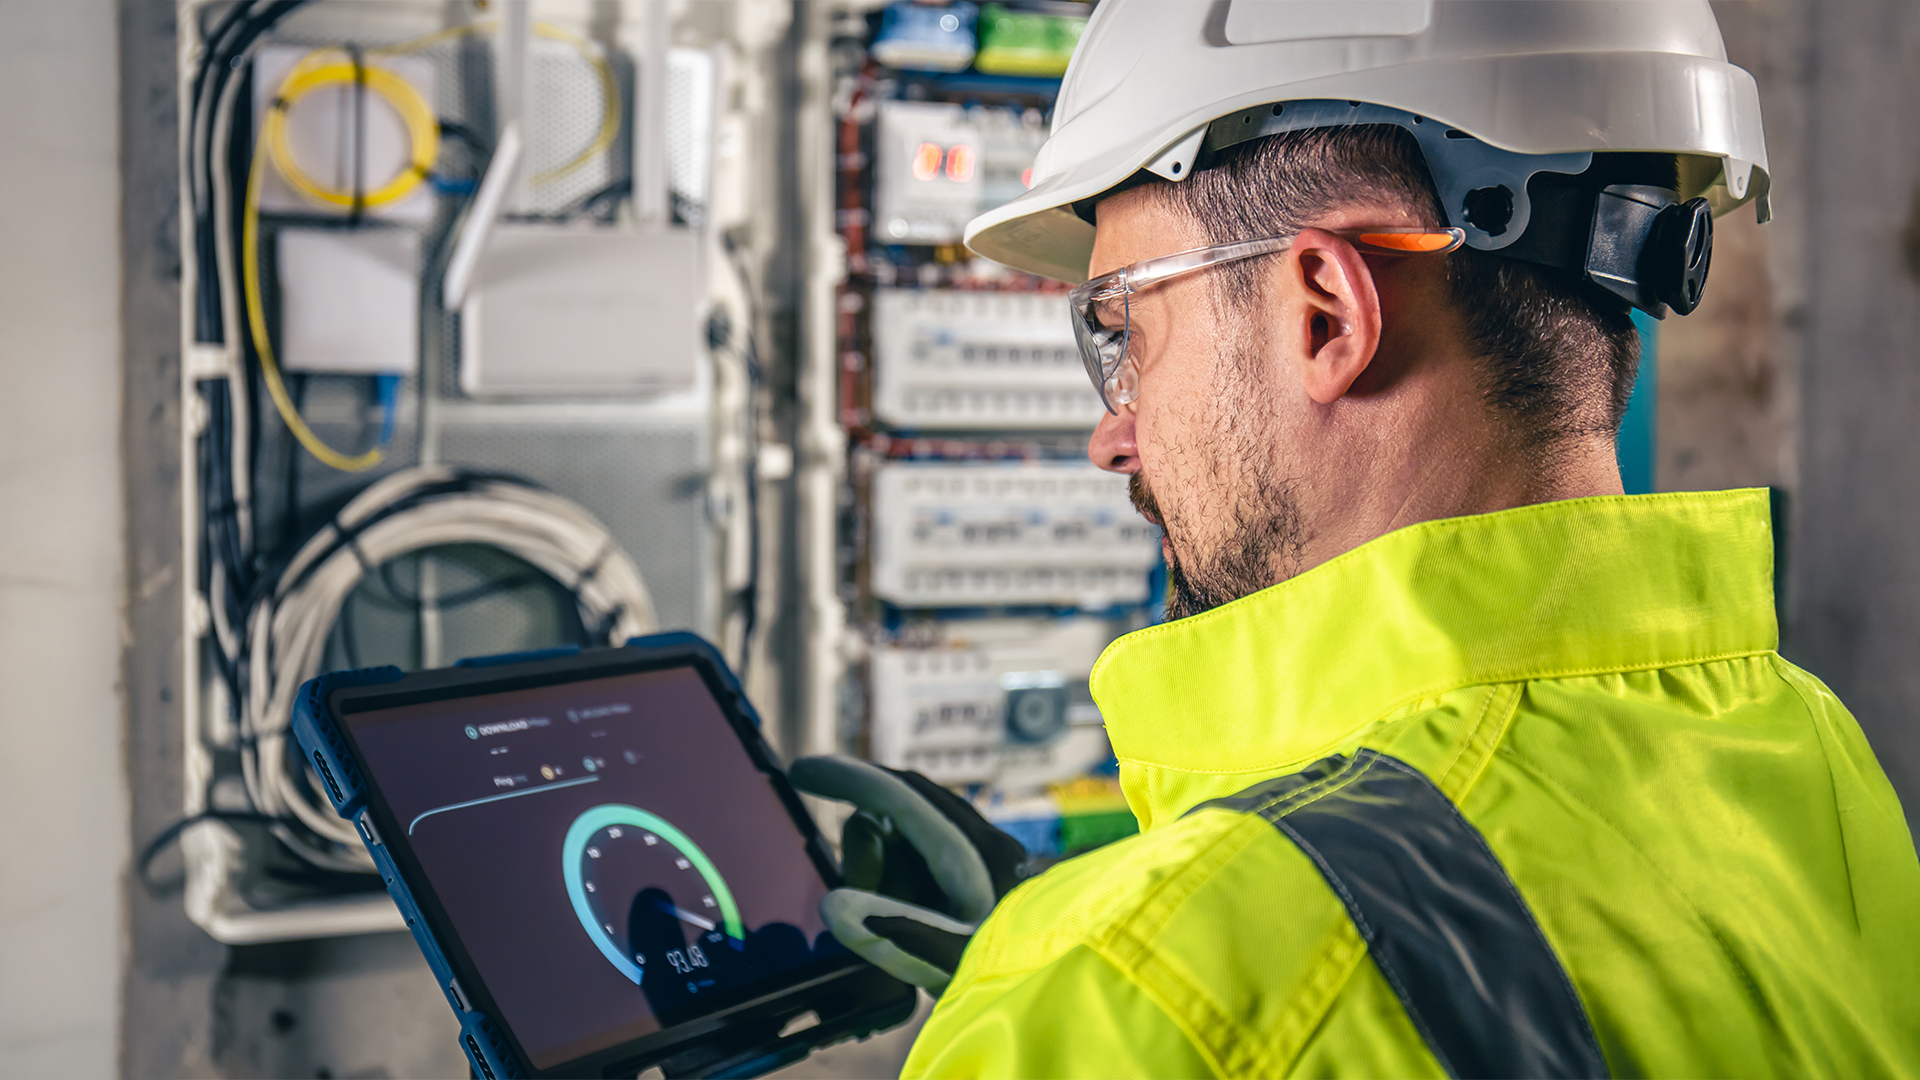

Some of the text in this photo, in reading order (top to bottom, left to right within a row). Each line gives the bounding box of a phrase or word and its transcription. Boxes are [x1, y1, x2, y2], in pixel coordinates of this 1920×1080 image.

[478, 717, 529, 736] DOWNLOAD
[493, 775, 516, 787] Ping
[585, 880, 596, 893] 5
[635, 953, 646, 965] 0
[666, 943, 710, 974] 93.48
